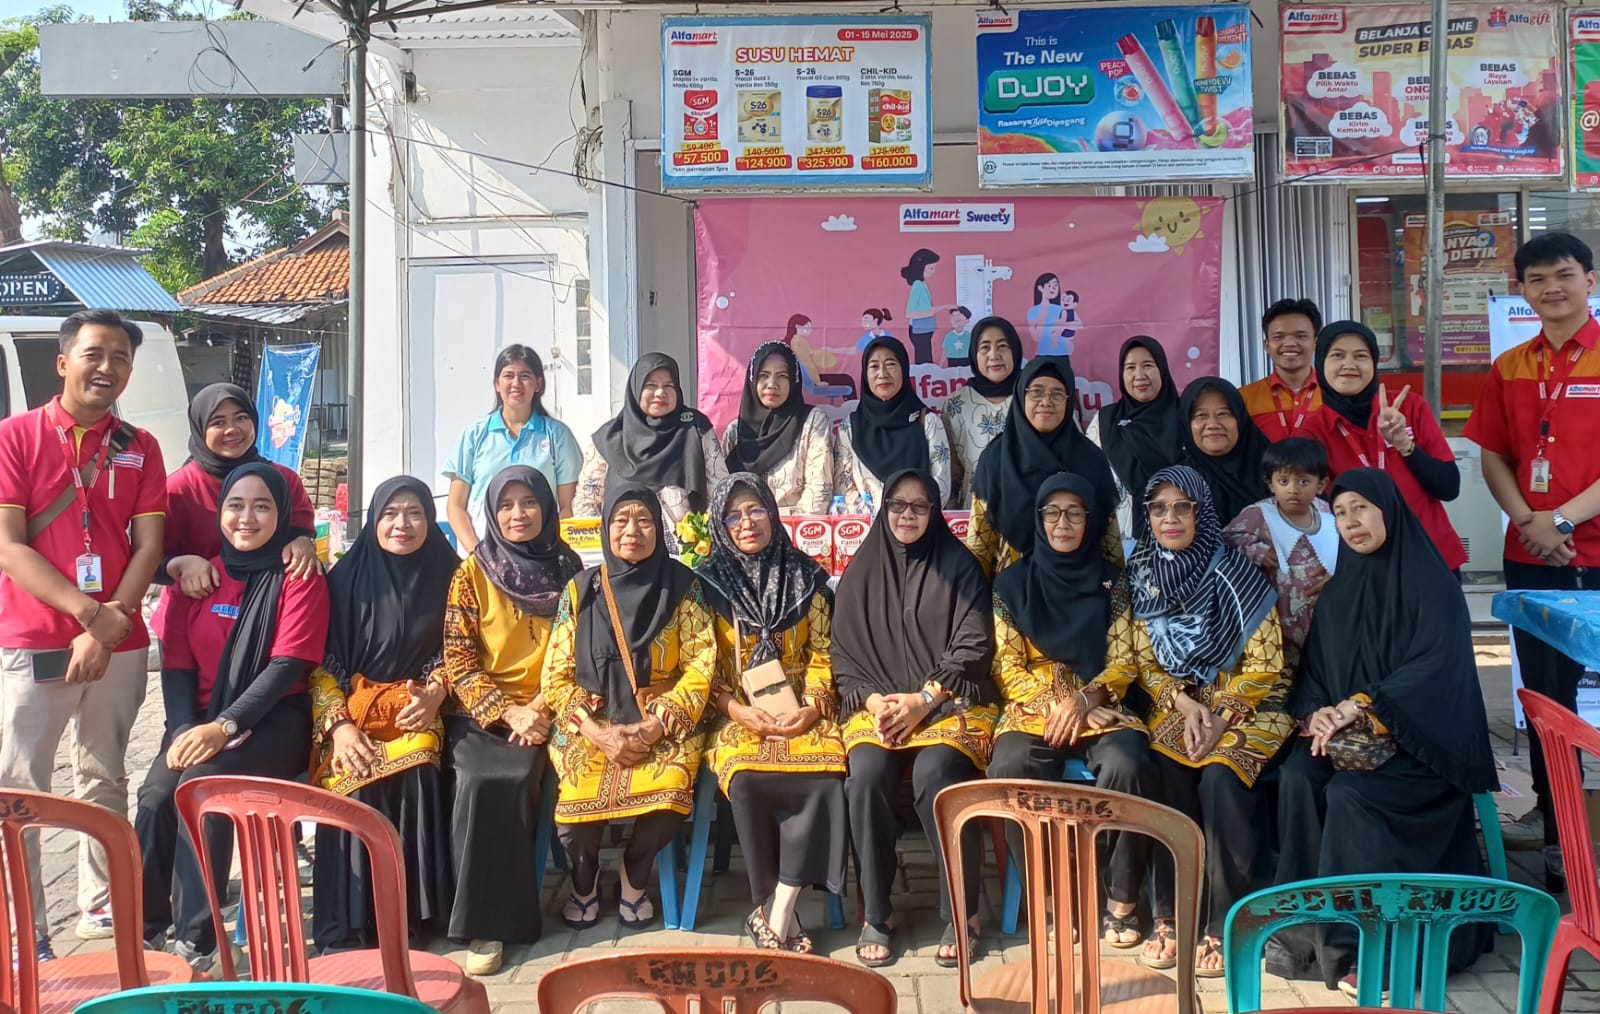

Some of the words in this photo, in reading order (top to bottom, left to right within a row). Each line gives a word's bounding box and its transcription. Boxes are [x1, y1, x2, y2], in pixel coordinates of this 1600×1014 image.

[977, 16, 1012, 24] Alfamart
[1288, 11, 1339, 21] Alfamart
[1508, 13, 1550, 25] Alfagift
[1578, 20, 1600, 29] Alfa
[671, 31, 718, 41] Alfamart
[1359, 27, 1420, 40] BELANJA
[1025, 36, 1046, 46] This
[1049, 36, 1058, 45] is
[736, 47, 785, 63] SUSU
[788, 47, 855, 63] HEMAT
[1358, 43, 1413, 58] SUPER
[1004, 52, 1035, 65] The
[1041, 50, 1083, 63] New
[1108, 68, 1123, 77] POP
[1480, 64, 1516, 72] BEBAS
[1318, 72, 1356, 80] BEBAS
[998, 75, 1087, 98] DJOY
[693, 97, 709, 105] SGM
[1339, 112, 1377, 120] BEBAS
[684, 152, 721, 163] 57.500
[745, 157, 787, 168] 124.900
[806, 156, 849, 168] 325.900
[870, 156, 913, 168] 160.000
[903, 208, 961, 219] Alfamart
[966, 208, 1011, 225] Sweety
[1450, 248, 1499, 262] DETIK
[0, 281, 48, 296] OPEN
[802, 526, 822, 536] SGM
[840, 525, 861, 535] SGM
